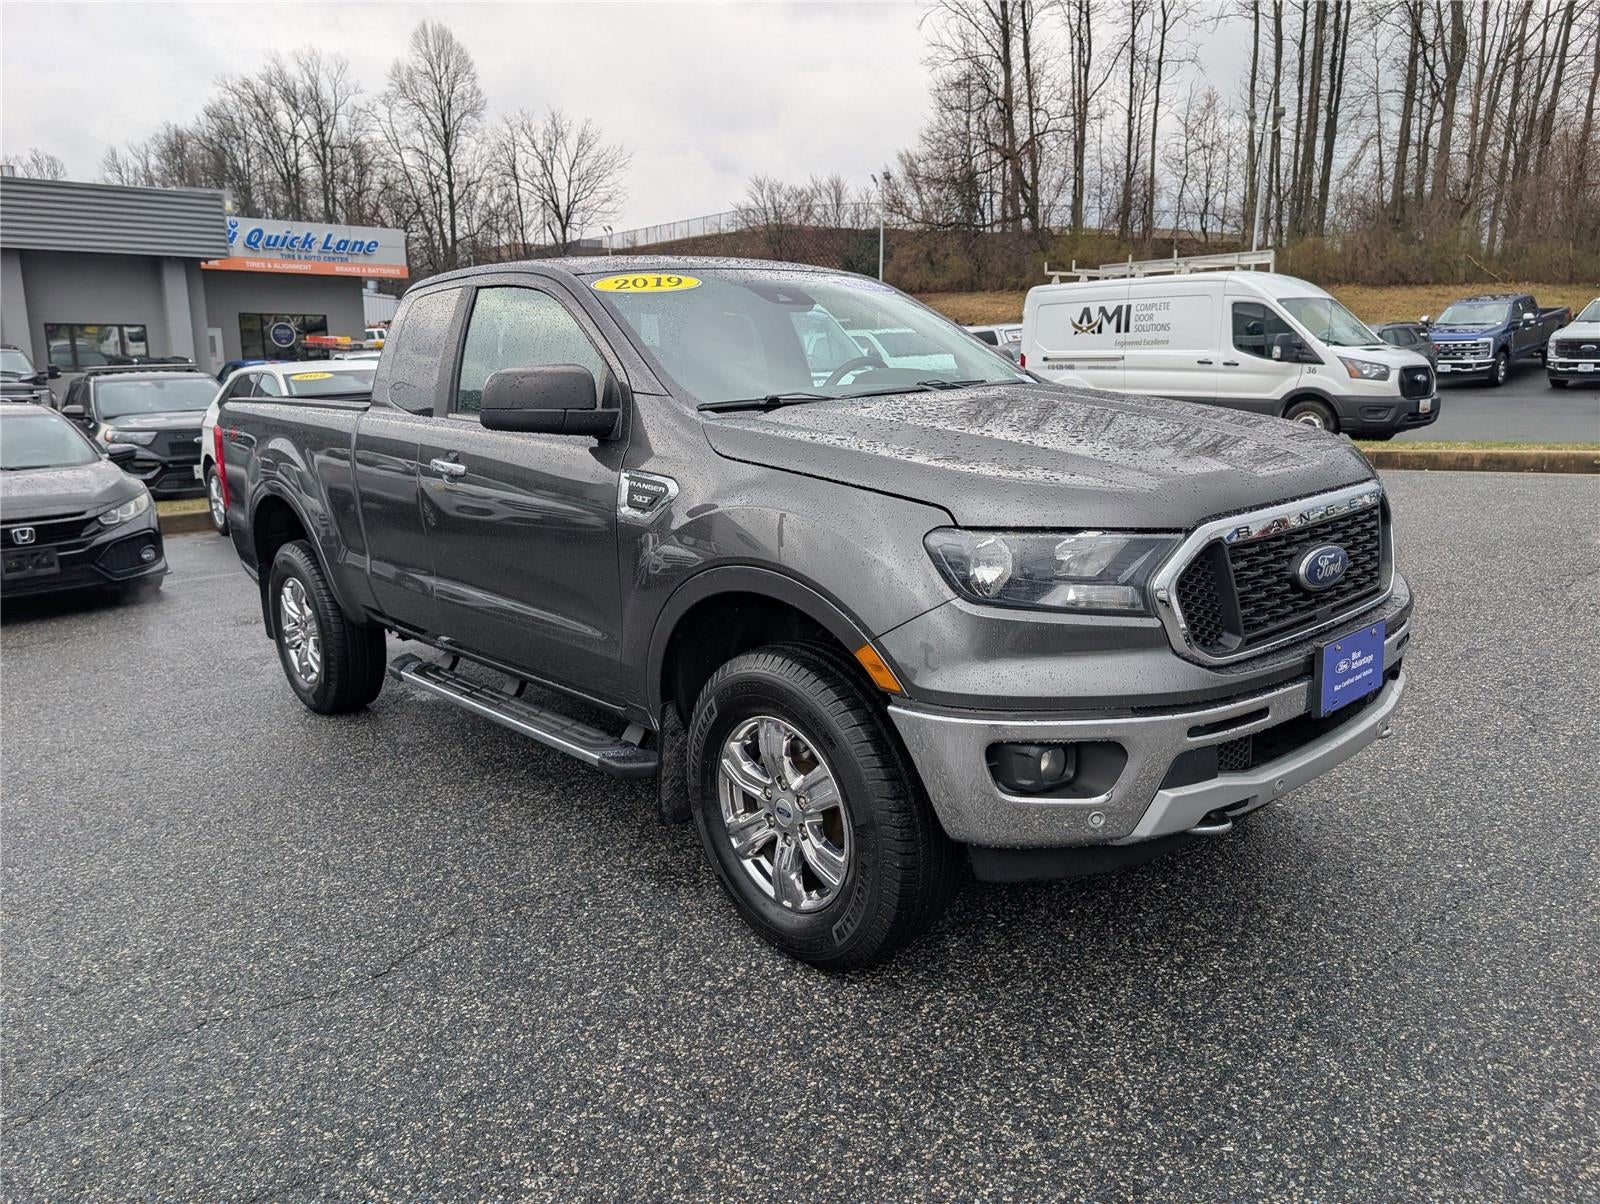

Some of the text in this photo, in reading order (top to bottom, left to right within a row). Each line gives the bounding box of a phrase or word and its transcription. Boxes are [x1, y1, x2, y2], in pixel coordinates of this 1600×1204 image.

[245, 228, 380, 254] Quick Lane
[280, 253, 296, 261] TIRE
[304, 254, 321, 262] AUTO
[245, 261, 266, 269] TIRES
[273, 263, 312, 271] ALIGNMENT
[367, 267, 400, 275] BATTERIES
[614, 276, 683, 290] 2019
[1135, 302, 1171, 312] COMPLETE
[1073, 304, 1132, 335] AMI
[1134, 313, 1154, 322] DOOR
[1133, 322, 1171, 333] SOLUTIONS
[1114, 338, 1169, 348] Engineered Excellence
[1306, 366, 1317, 375] 36
[629, 480, 665, 493] RANGER
[632, 494, 652, 503] XLT
[1236, 493, 1377, 538] RANGER
[1317, 553, 1343, 581] Ford
[1351, 650, 1361, 661] Blue
[1351, 654, 1374, 670] Advantage
